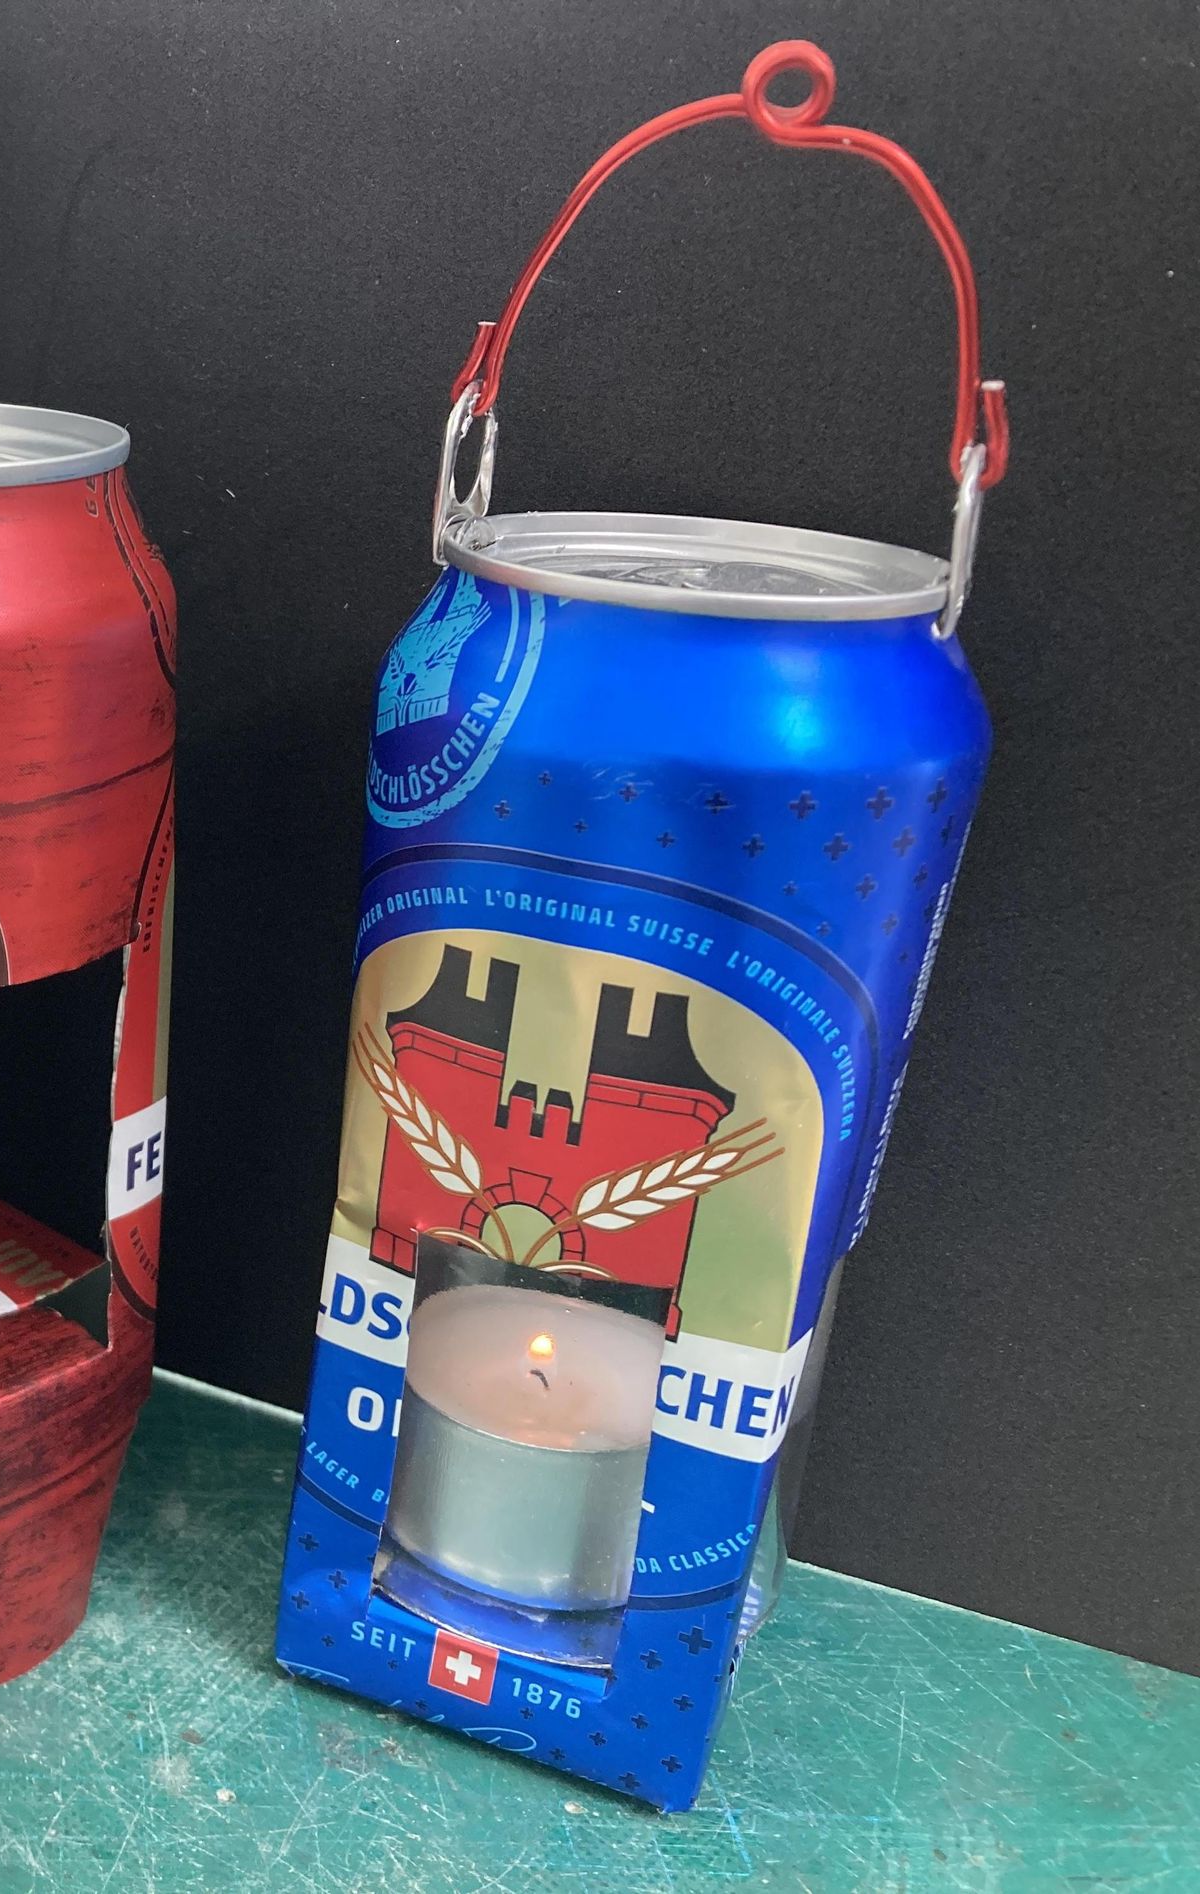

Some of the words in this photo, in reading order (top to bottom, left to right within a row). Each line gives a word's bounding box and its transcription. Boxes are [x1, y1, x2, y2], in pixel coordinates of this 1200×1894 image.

[386, 887, 468, 914] ORIGINAL
[485, 888, 616, 928] L'ORIGINAL
[627, 915, 714, 956] SUISSE
[726, 950, 840, 1044] L'ORIGINALE
[831, 1044, 855, 1141] SVIZZERA
[126, 1131, 161, 1191] FE
[306, 1441, 360, 1488] LAGER
[371, 1488, 390, 1505] B
[351, 1621, 416, 1658] SEIT
[512, 1677, 581, 1719] 1876
